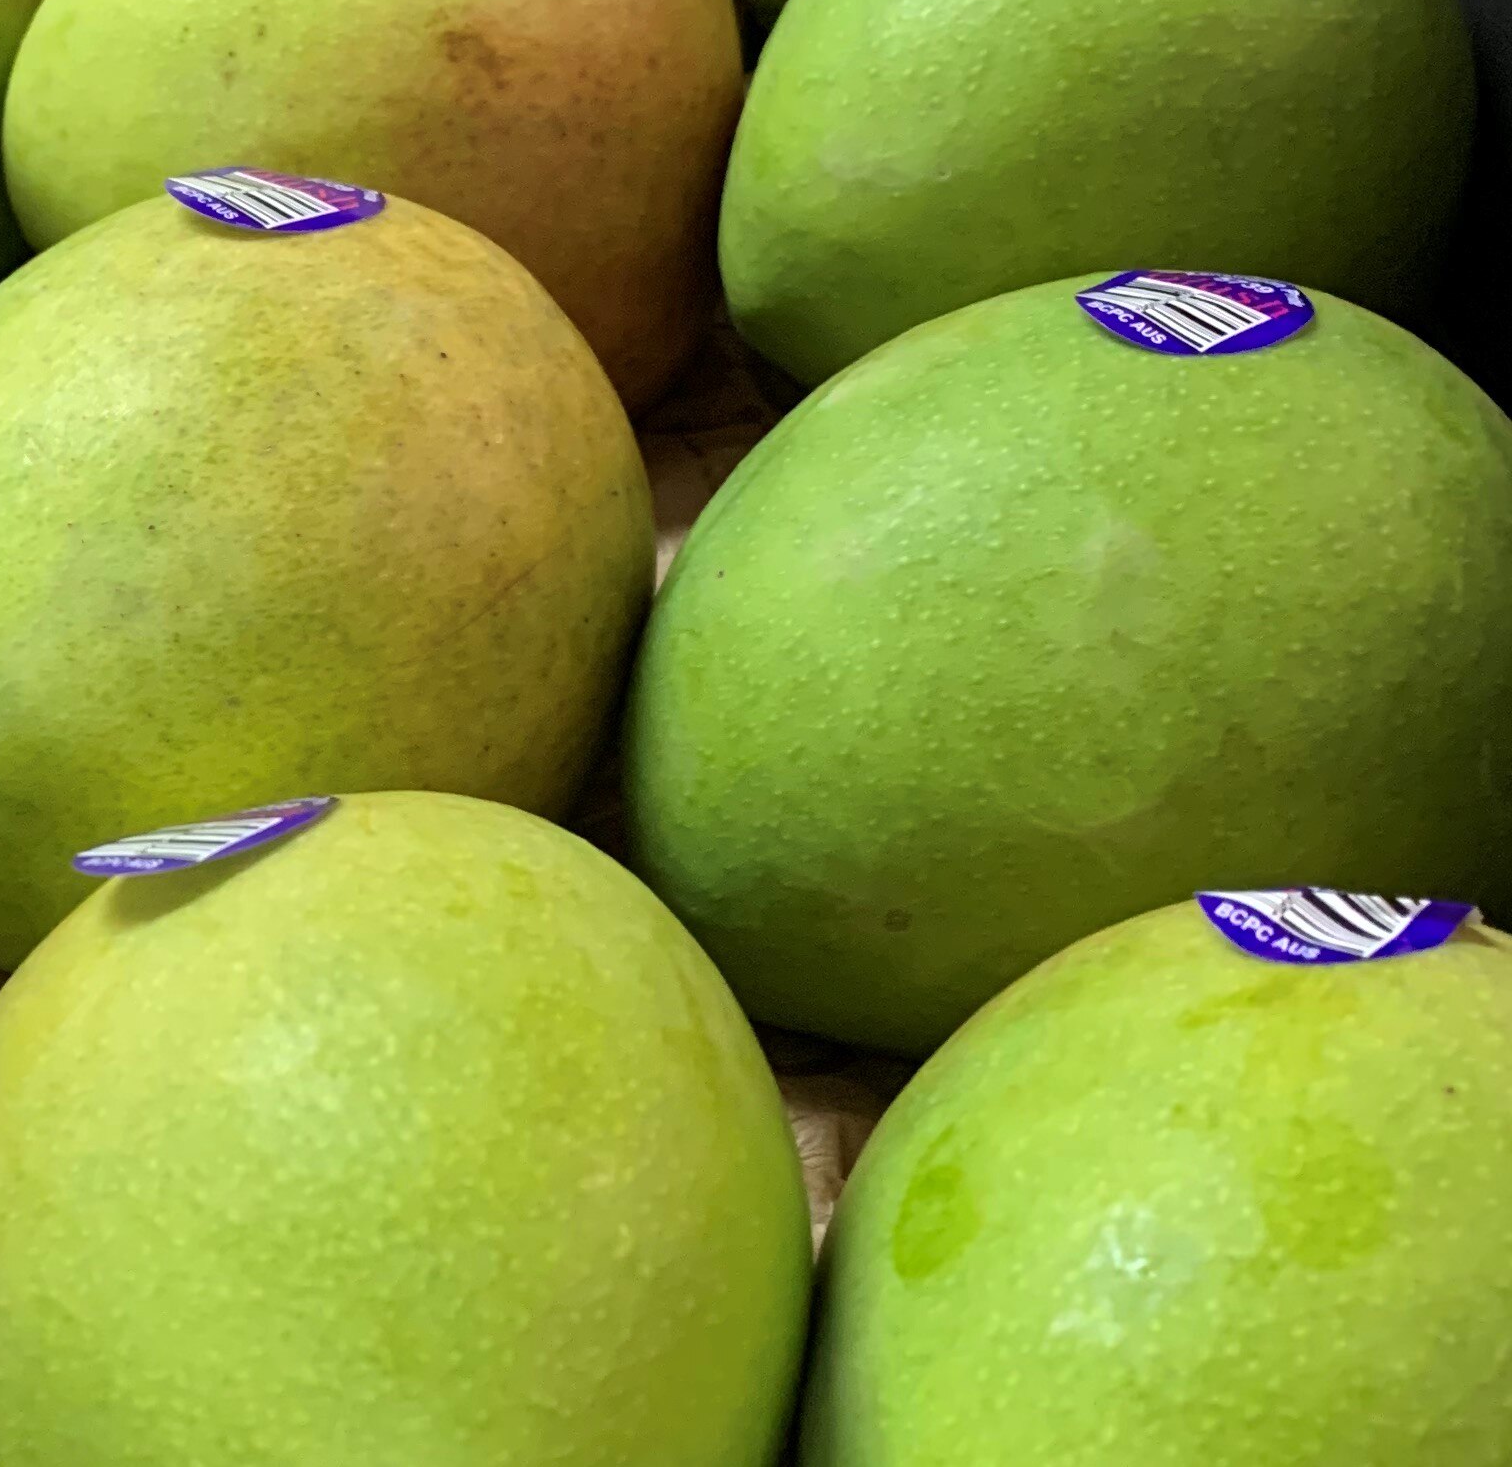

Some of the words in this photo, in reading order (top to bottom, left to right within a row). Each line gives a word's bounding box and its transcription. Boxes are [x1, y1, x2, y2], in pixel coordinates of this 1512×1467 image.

[206, 202, 239, 221] AUS
[1087, 299, 1135, 324] BCPC
[1129, 321, 1168, 346] AUS
[1213, 901, 1276, 943] BCPC
[1270, 936, 1322, 961] AUS
